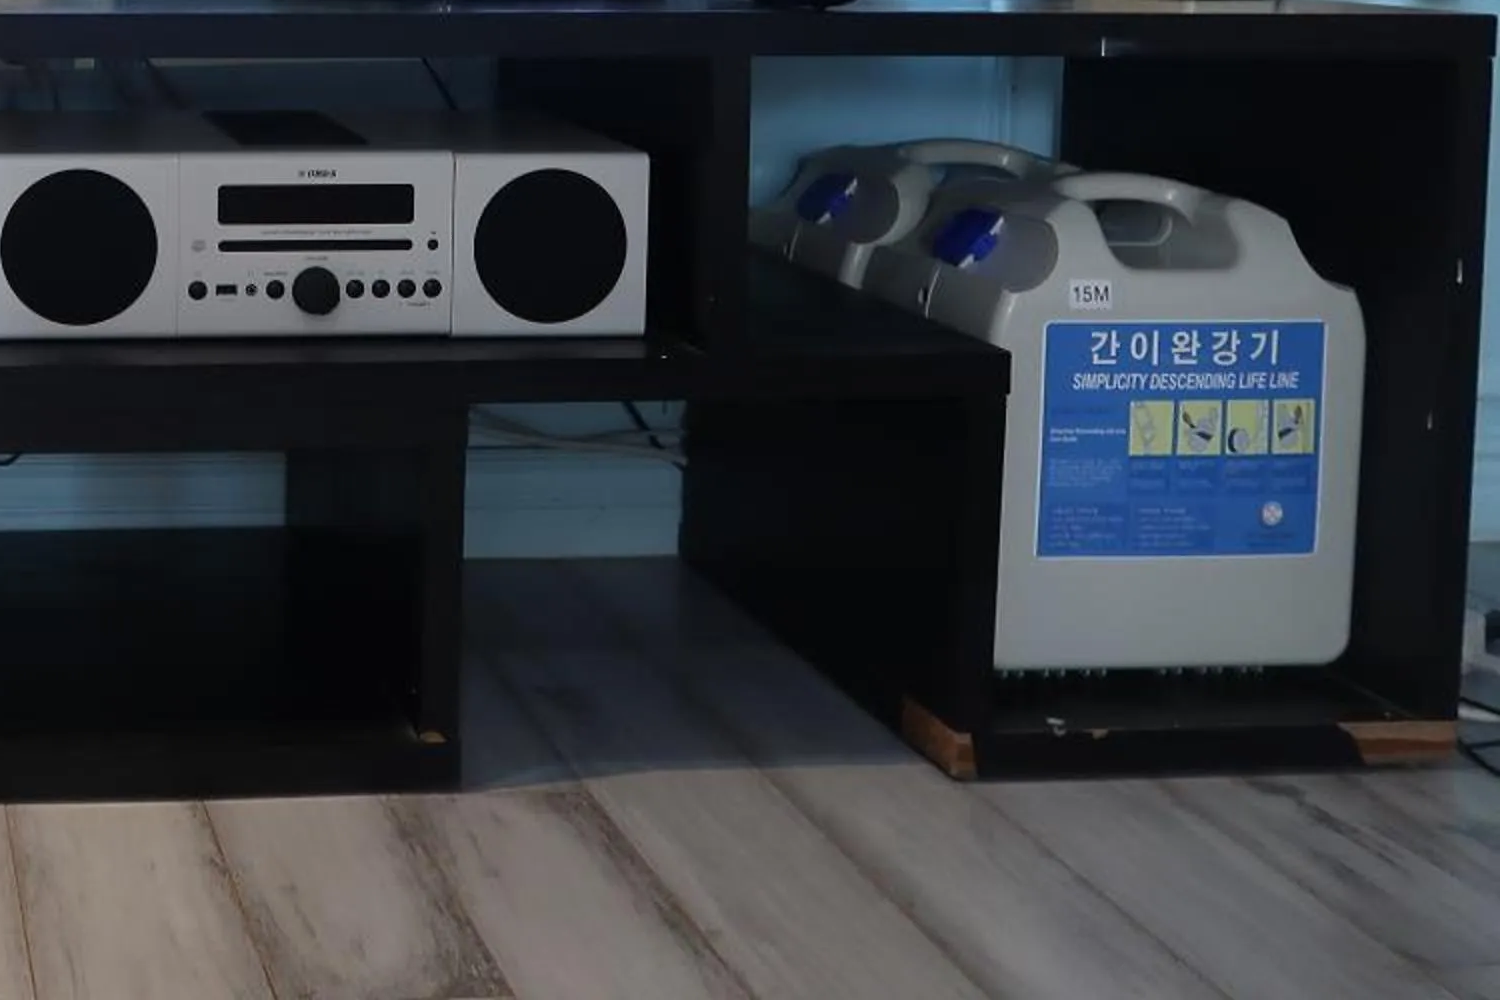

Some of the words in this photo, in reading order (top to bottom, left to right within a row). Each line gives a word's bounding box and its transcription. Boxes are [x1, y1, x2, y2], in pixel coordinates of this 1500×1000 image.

[1073, 287, 1110, 304] 15M
[1090, 330, 1281, 366] 간이완강기
[1072, 373, 1148, 391] SIMPLICITY
[1149, 373, 1237, 390] DESCENDING
[1239, 372, 1268, 390] LIFE
[1269, 371, 1300, 389] LINE
